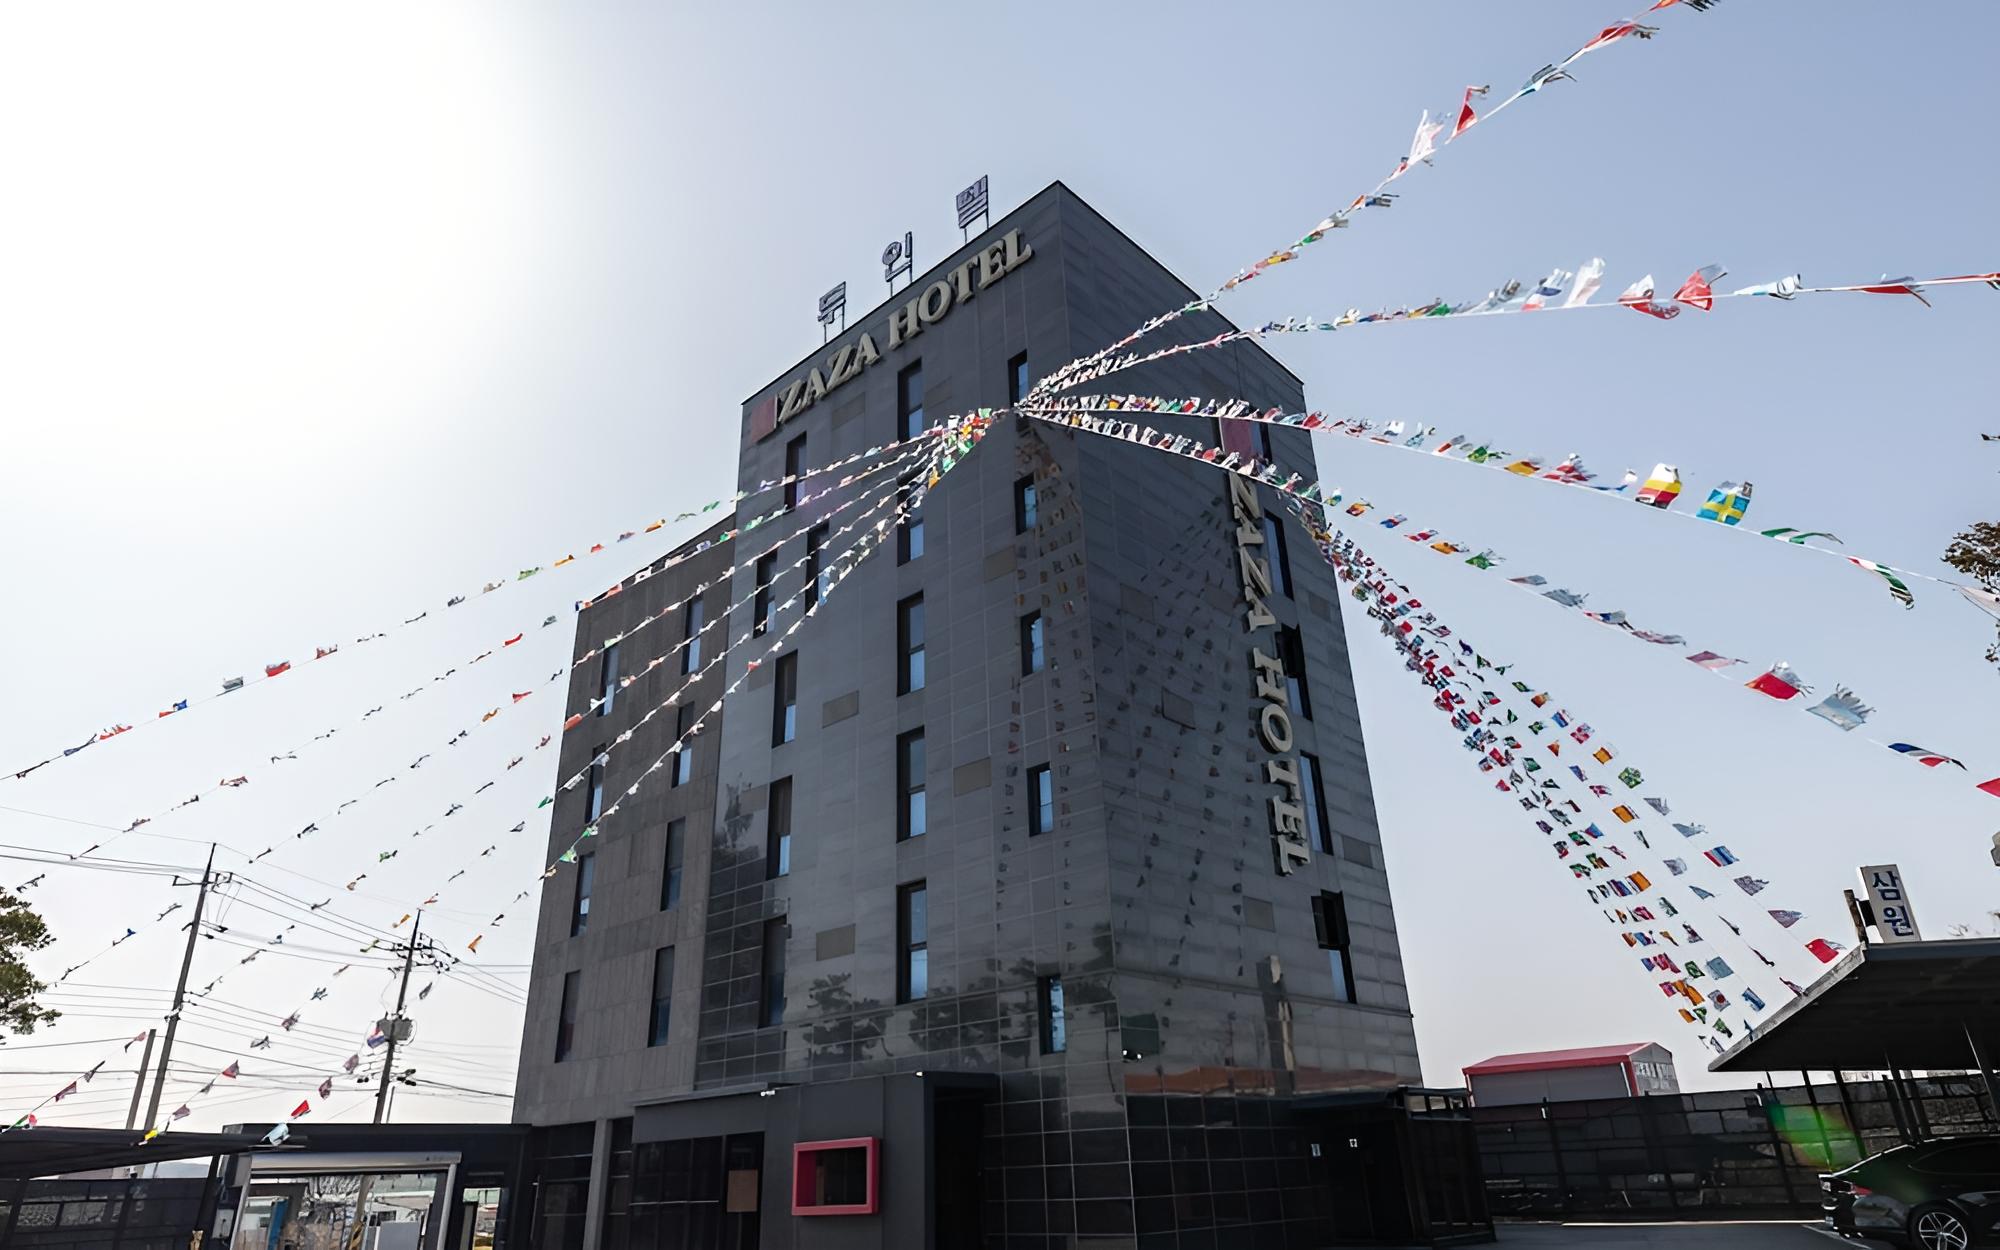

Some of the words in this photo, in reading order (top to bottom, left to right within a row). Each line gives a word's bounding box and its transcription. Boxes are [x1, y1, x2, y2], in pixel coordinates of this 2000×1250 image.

[777, 332, 880, 424] ZAZA
[887, 228, 1033, 350] HOTEL
[1228, 472, 1277, 633] ZAZA
[1253, 647, 1312, 876] HOTEL
[1872, 870, 1914, 937] 삼원
